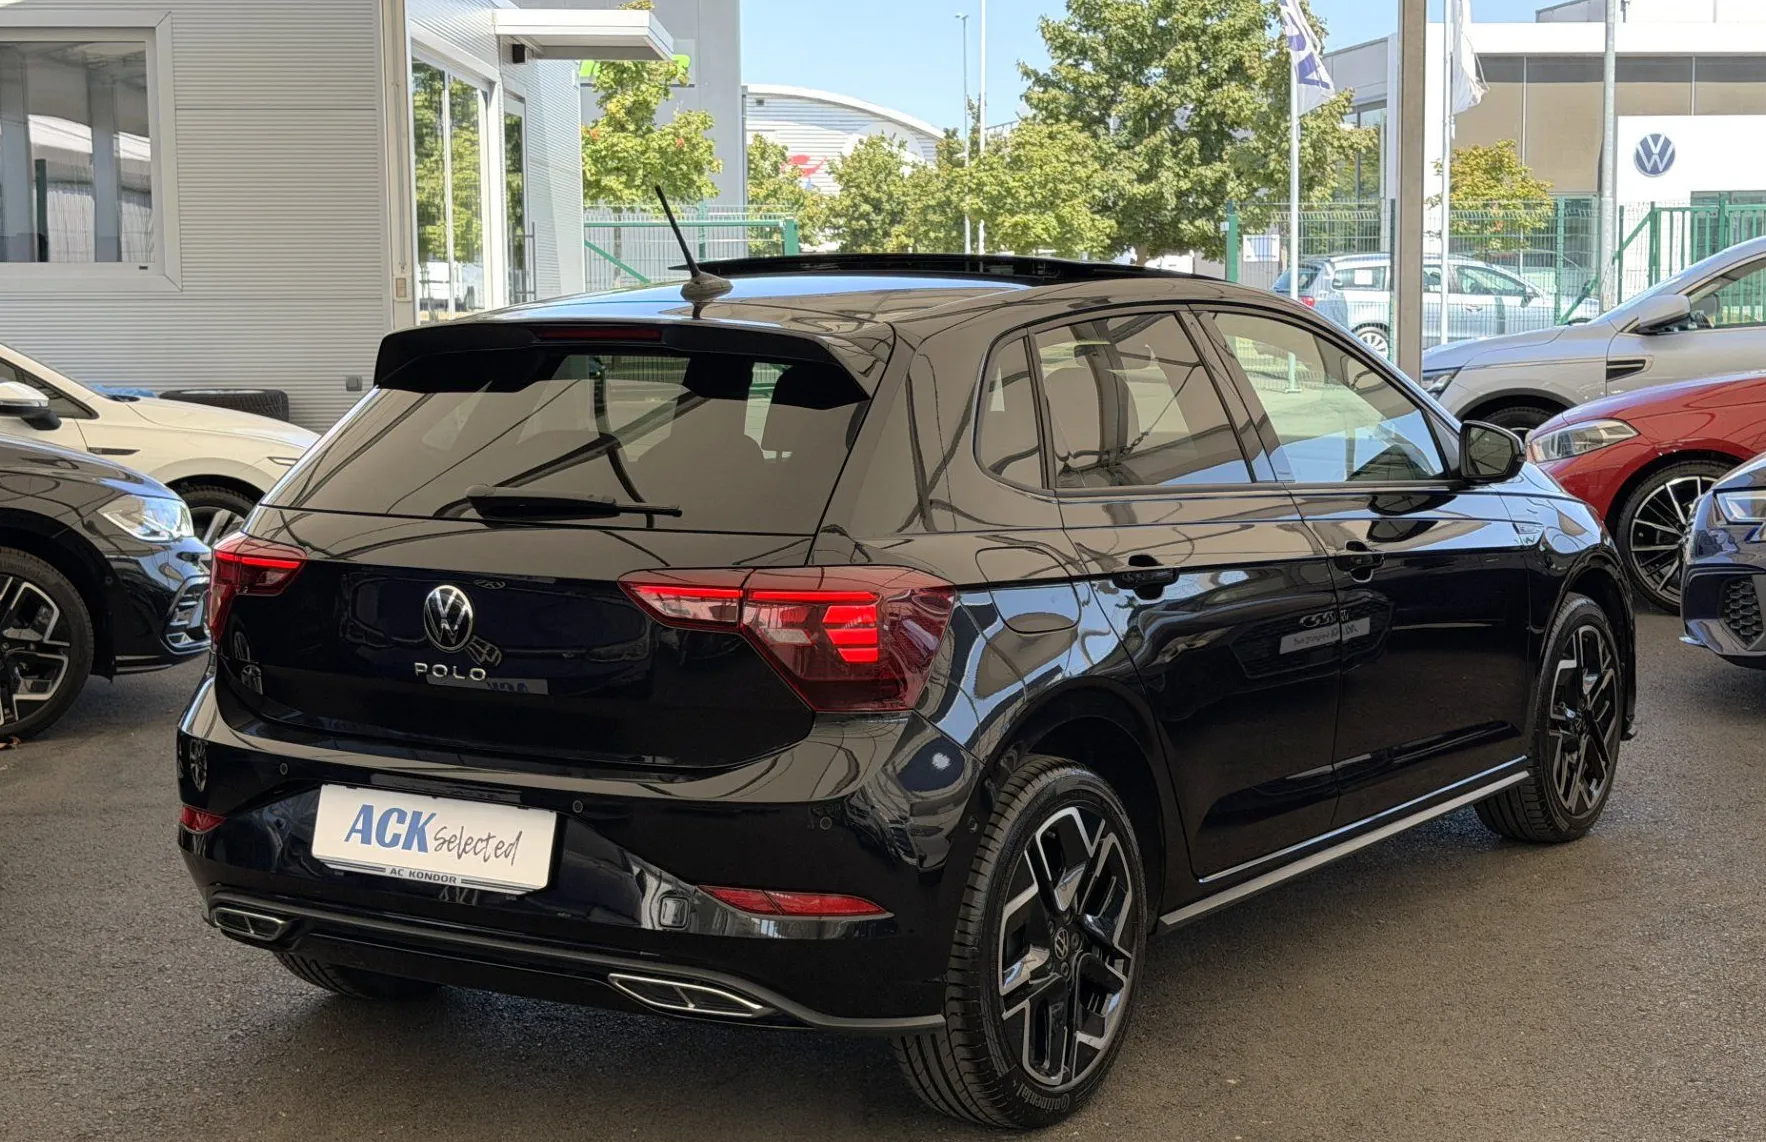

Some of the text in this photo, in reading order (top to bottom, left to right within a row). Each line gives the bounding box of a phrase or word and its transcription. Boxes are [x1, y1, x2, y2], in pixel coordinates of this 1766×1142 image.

[414, 662, 486, 681] POLO
[344, 804, 523, 866] ACK Selected
[389, 868, 457, 884] AC KONDOR
